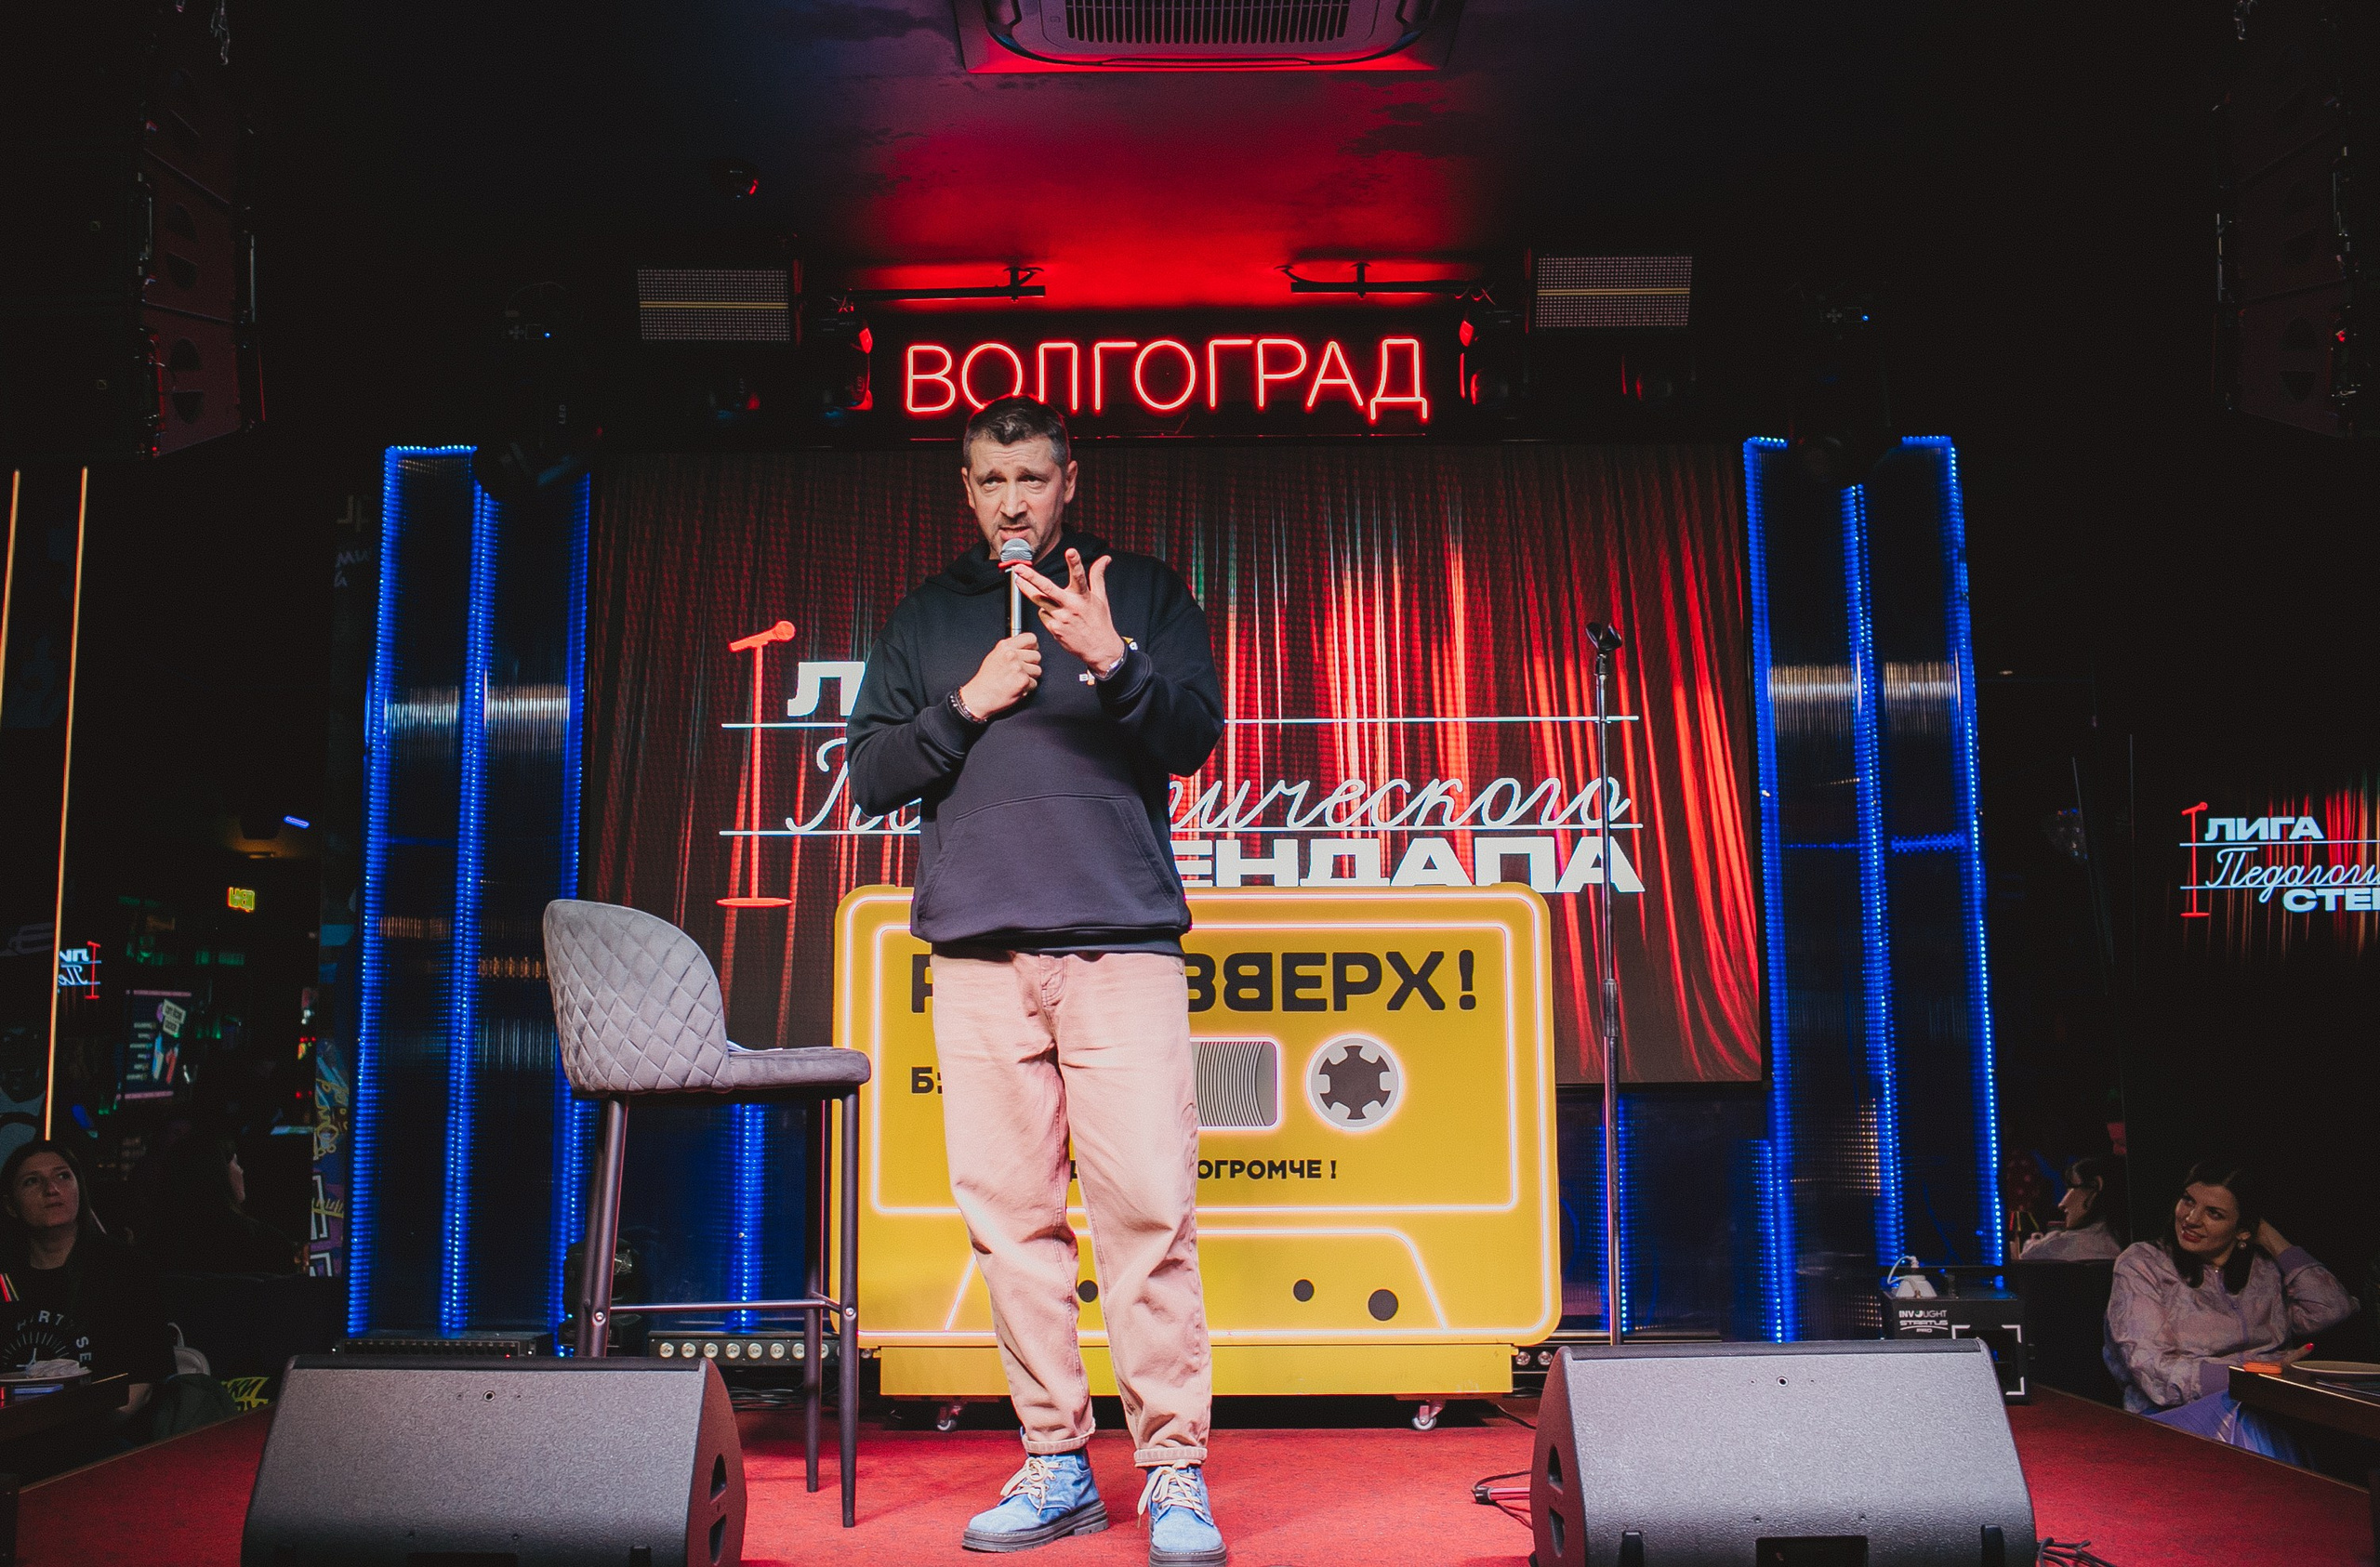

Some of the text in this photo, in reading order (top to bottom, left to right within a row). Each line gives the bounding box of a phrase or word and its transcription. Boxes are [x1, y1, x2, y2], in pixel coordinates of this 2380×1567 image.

[2205, 816, 2324, 841] ЛИГА
[1170, 836, 1646, 893] ЕНДАПА
[2282, 888, 2380, 914] СТЕ
[1197, 1159, 1322, 1180] ОГРОМЧЕ
